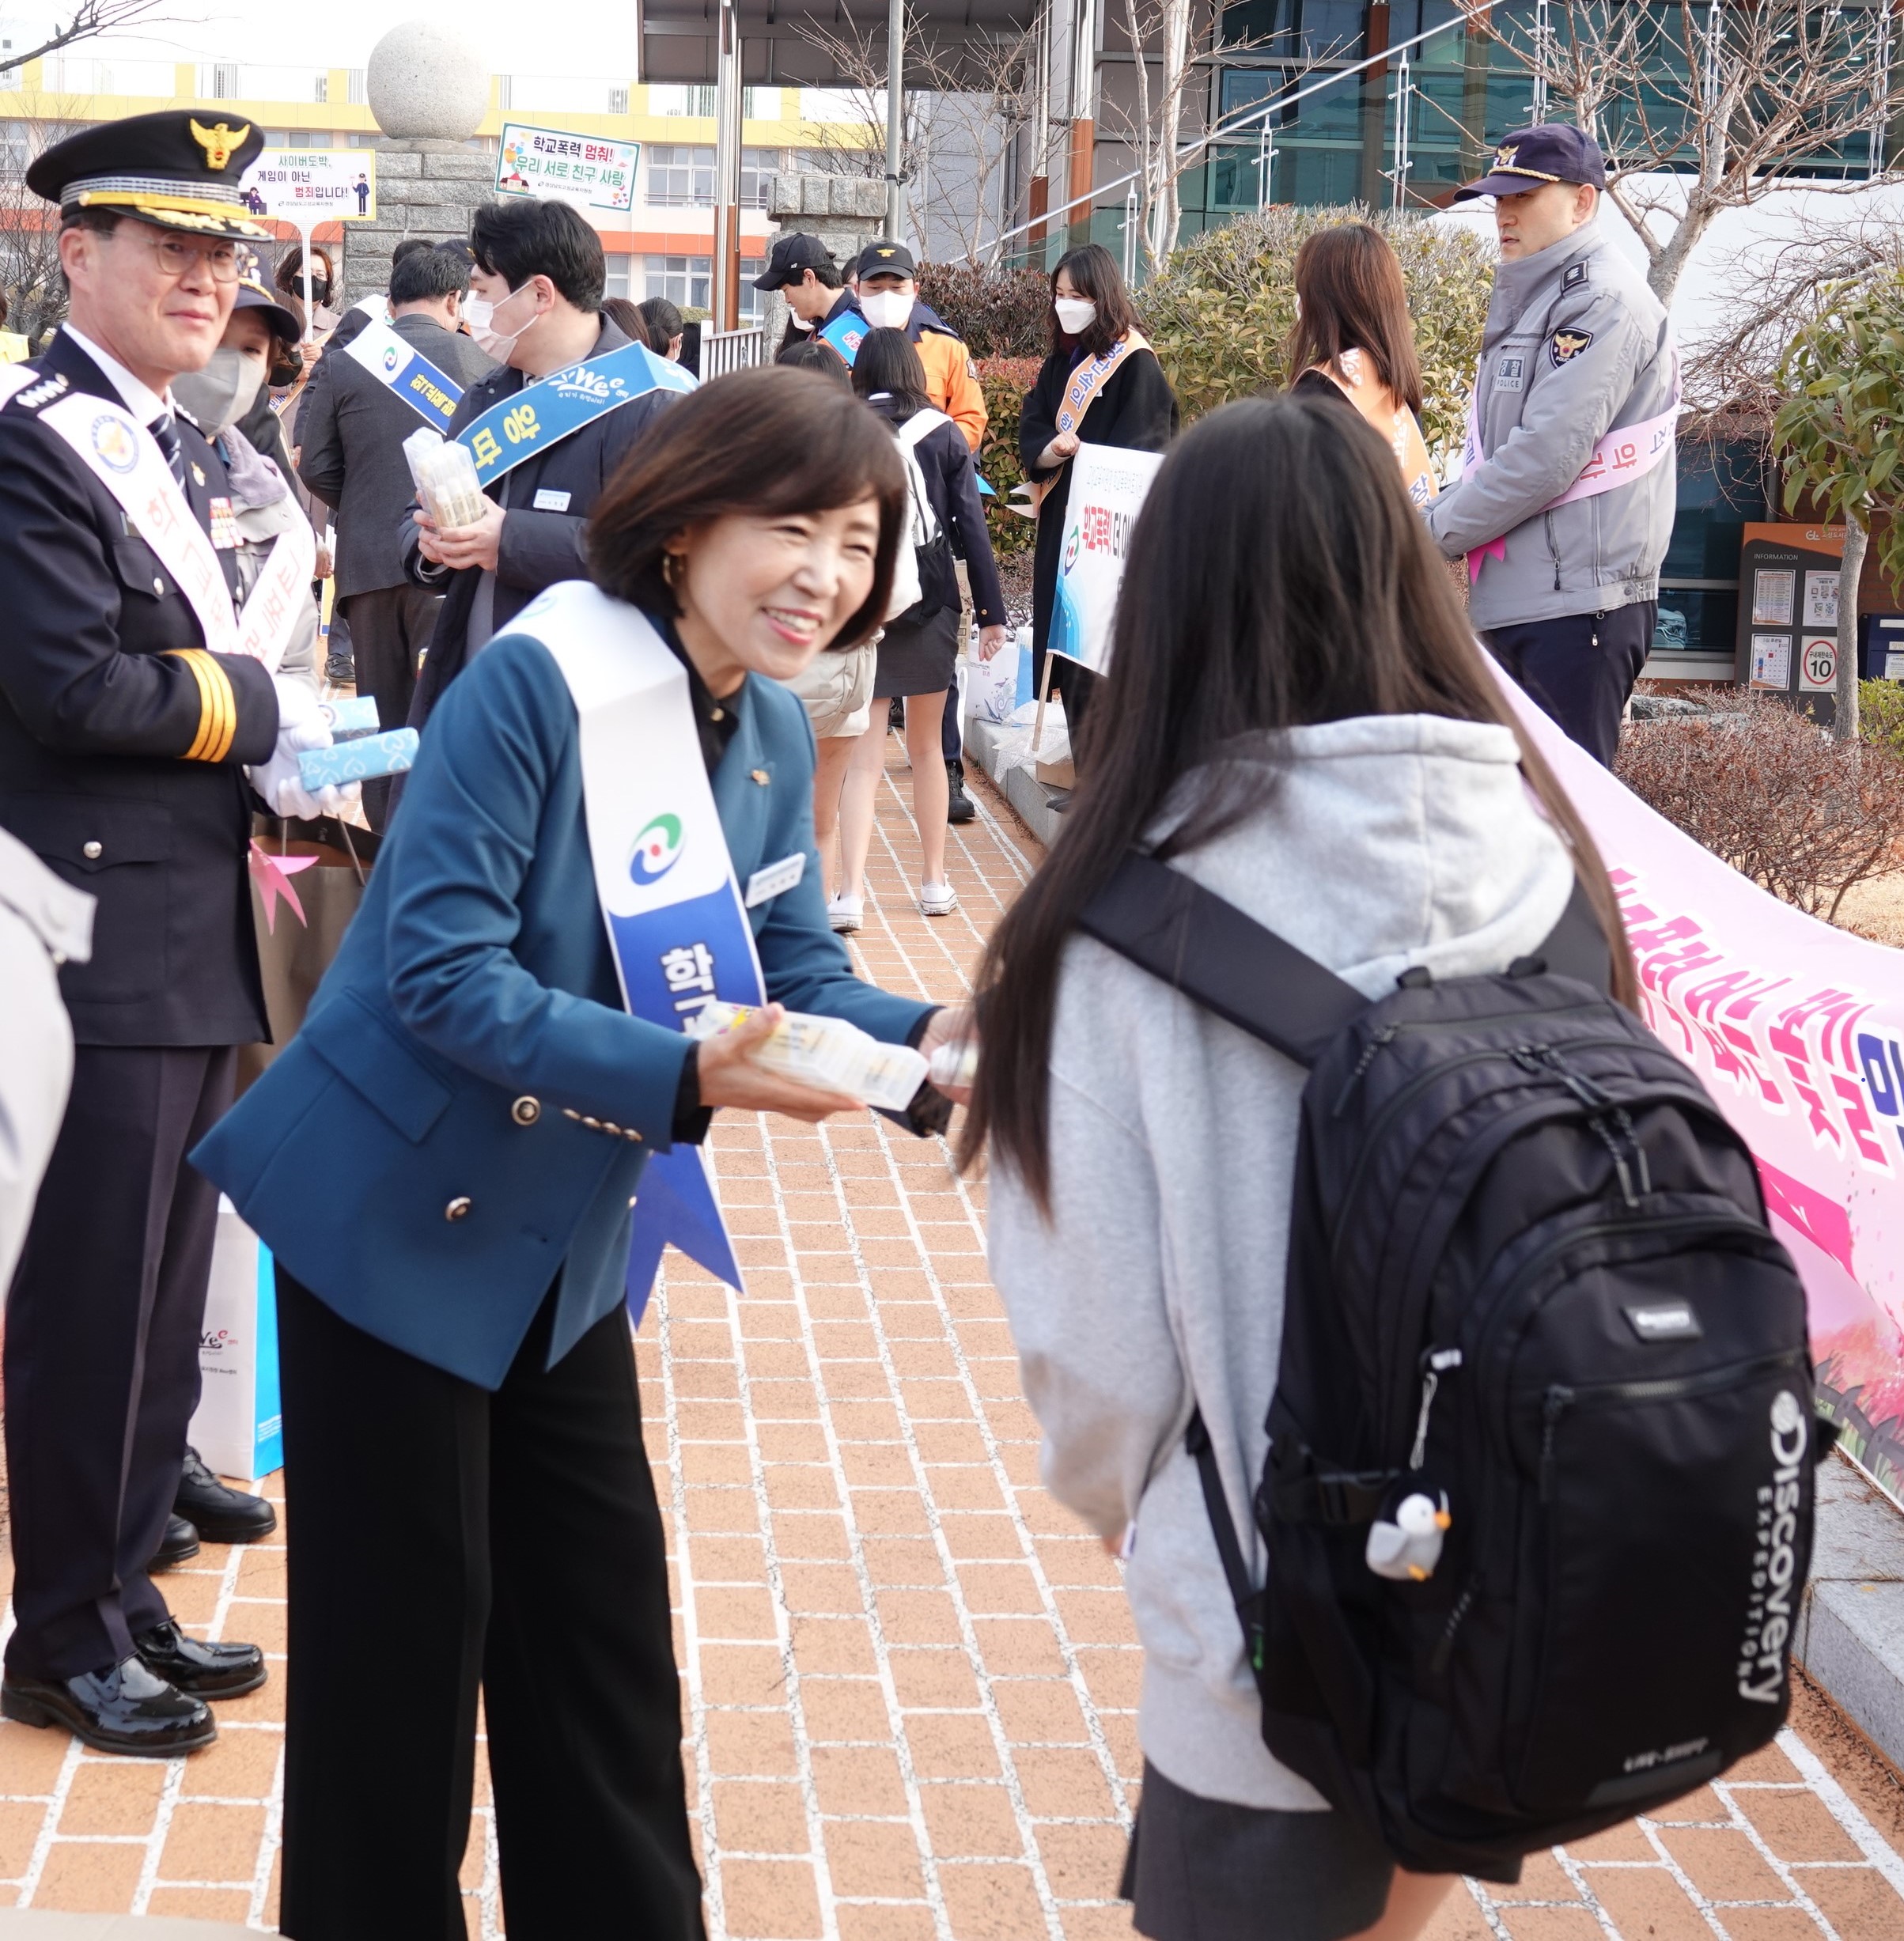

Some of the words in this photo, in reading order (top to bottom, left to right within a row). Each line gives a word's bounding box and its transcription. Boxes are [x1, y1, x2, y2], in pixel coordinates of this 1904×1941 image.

[533, 135, 581, 158] 학교폭력
[585, 143, 615, 163] 멈춰!
[278, 155, 331, 168] 사이버도박,
[257, 170, 286, 183] 게임이
[291, 170, 310, 183] 아닌
[516, 155, 541, 174] 우리
[543, 159, 569, 178] 서로
[572, 164, 596, 183] 친구
[599, 168, 625, 187] 사랑
[295, 186, 348, 199] 범죄입니다!
[1500, 360, 1520, 376] 경찰
[574, 366, 625, 397] Wee
[1497, 379, 1520, 388] POLICE
[409, 373, 458, 418] 학교폭력
[1810, 660, 1831, 678] 10
[1737, 1485, 1773, 1678] EXPEDITION
